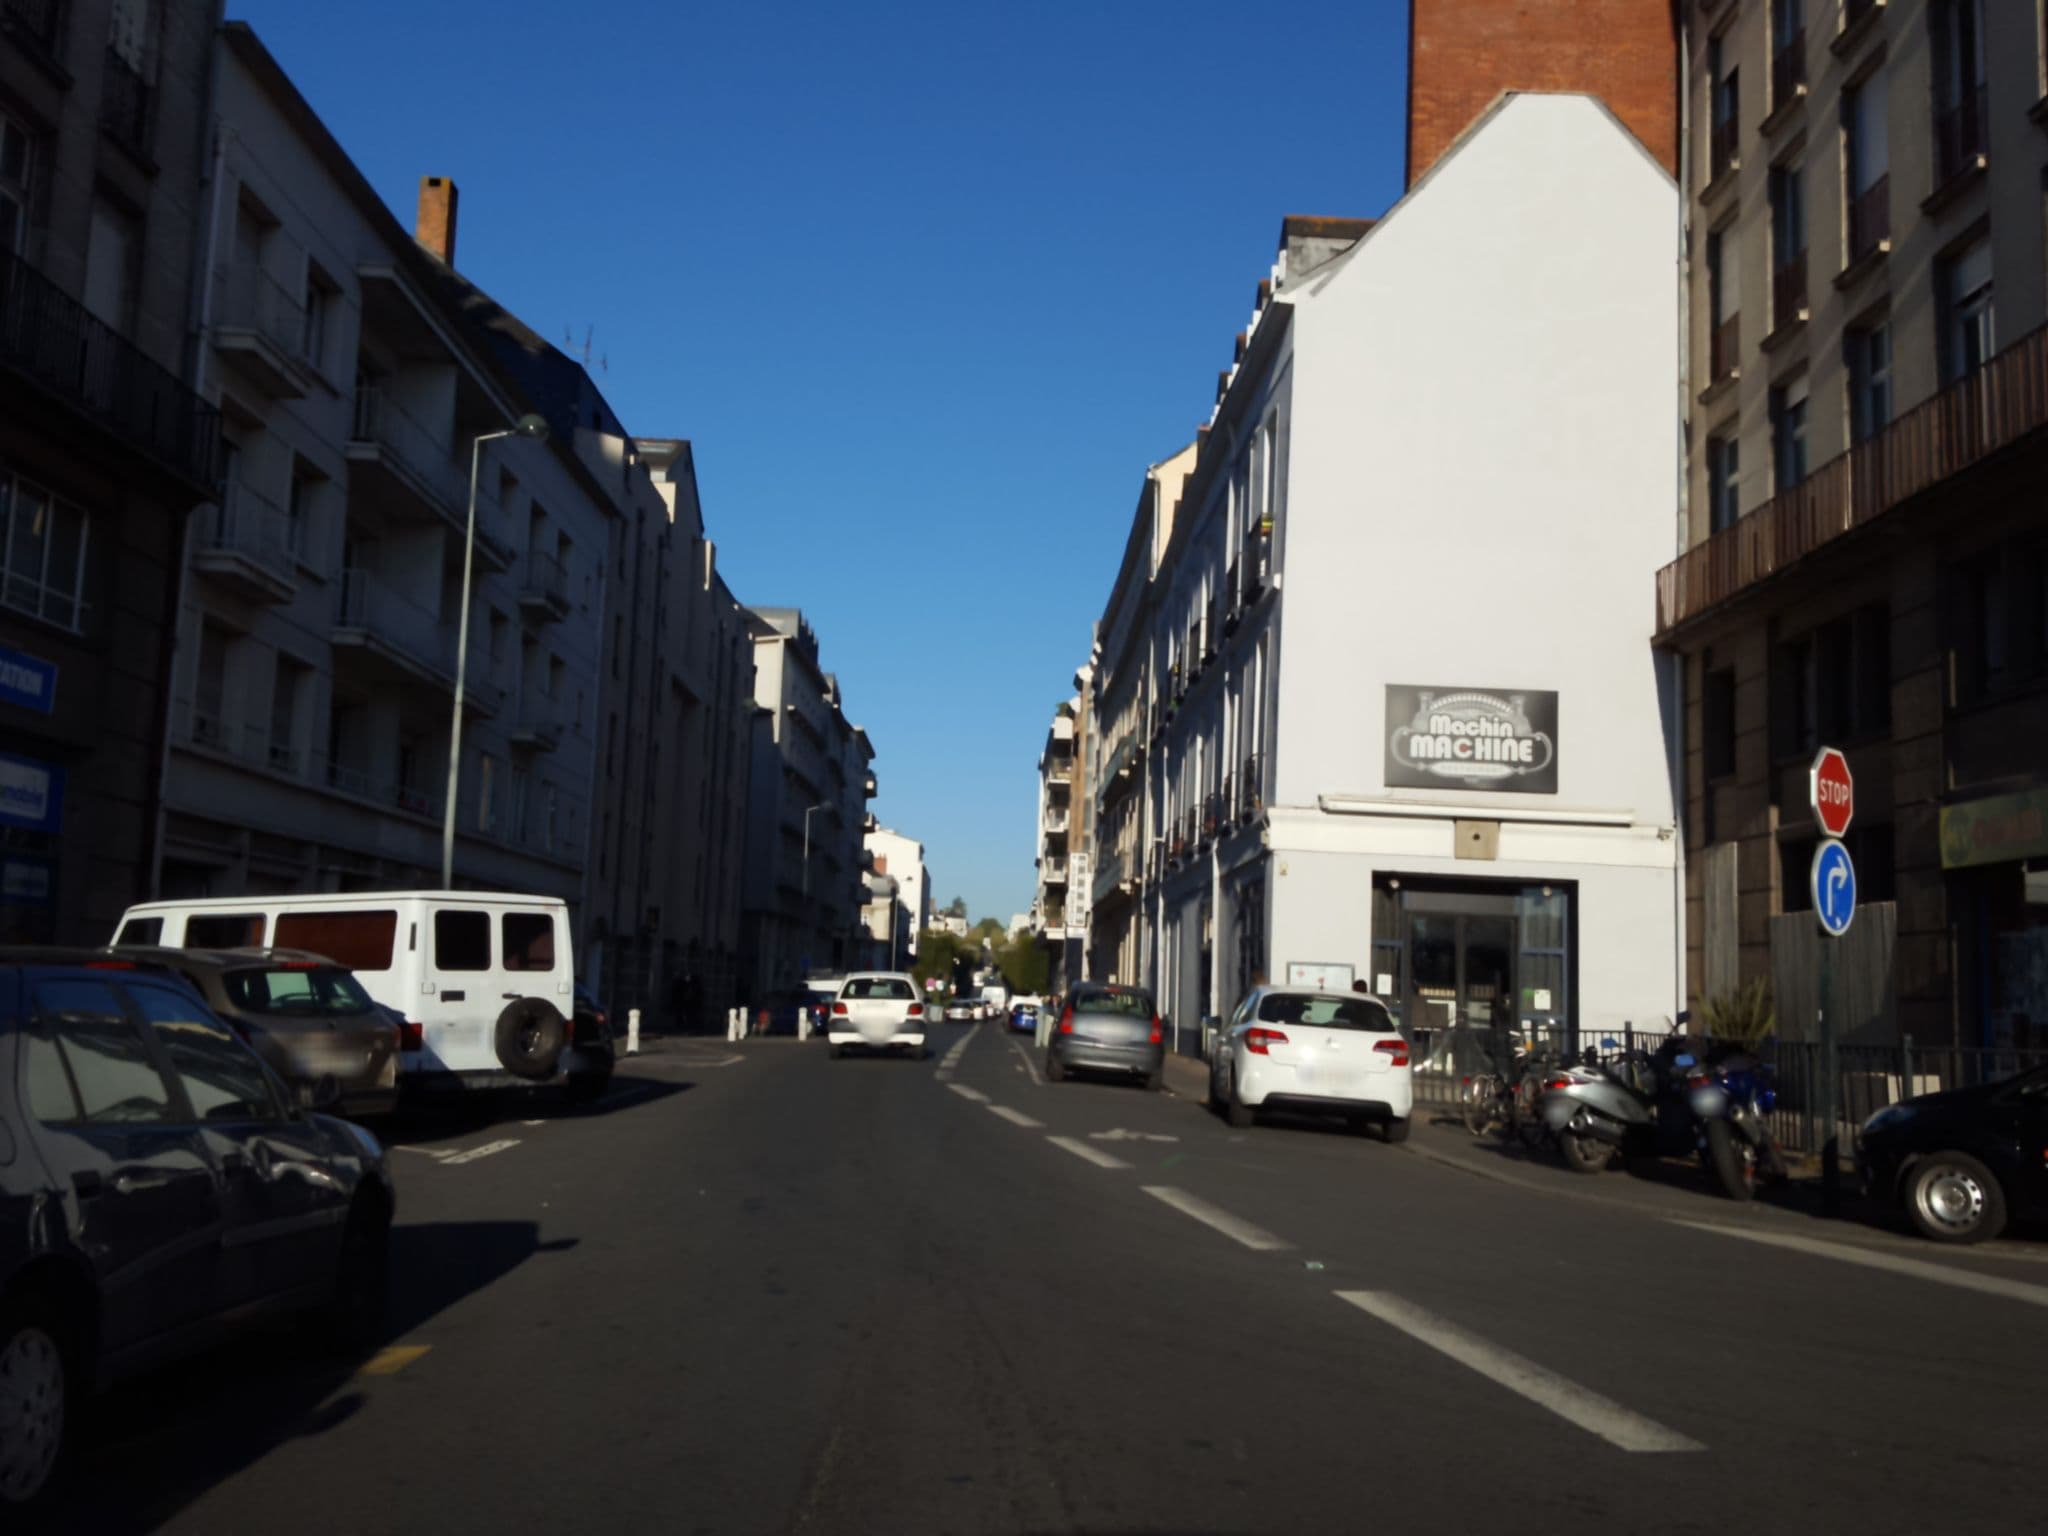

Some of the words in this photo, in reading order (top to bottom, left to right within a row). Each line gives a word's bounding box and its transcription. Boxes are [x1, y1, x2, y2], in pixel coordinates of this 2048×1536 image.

[1430, 714, 1514, 737] Machin
[1410, 735, 1533, 762] MACHINE
[1819, 778, 1849, 807] STOP
